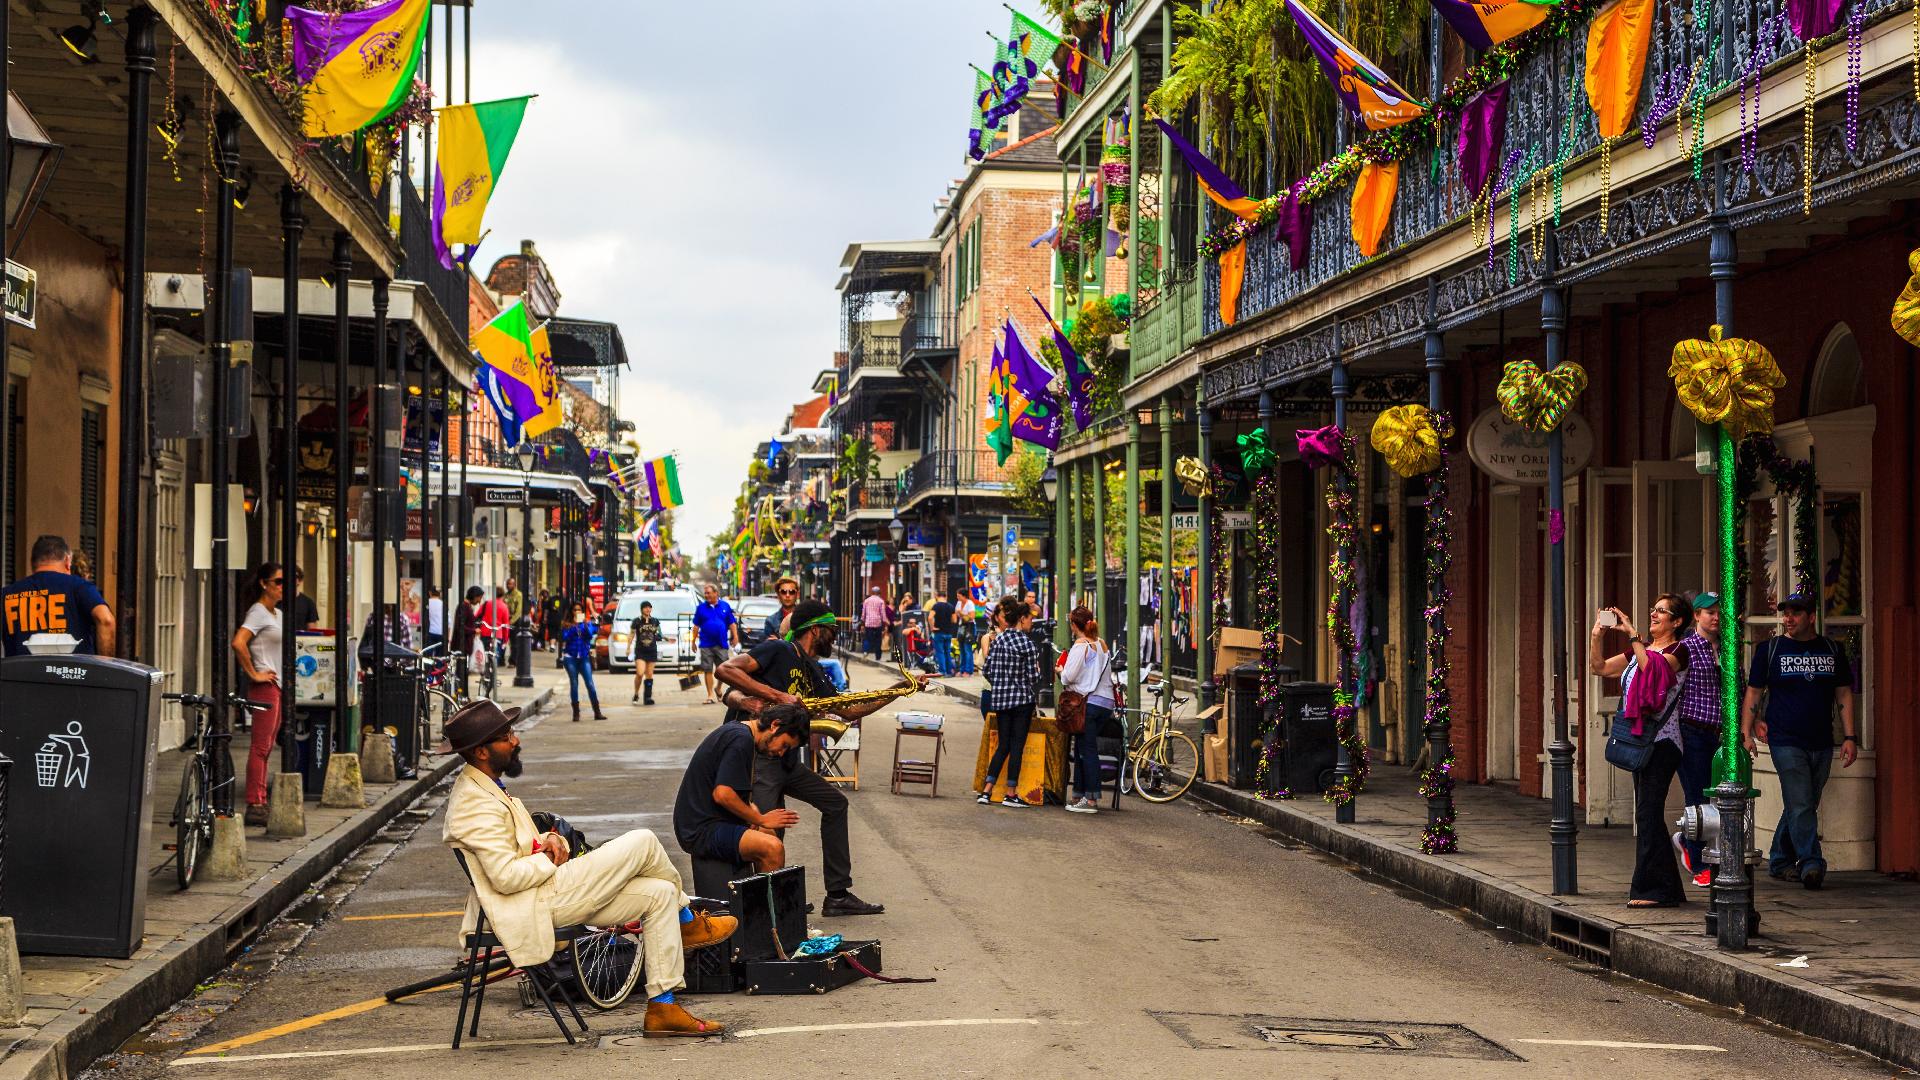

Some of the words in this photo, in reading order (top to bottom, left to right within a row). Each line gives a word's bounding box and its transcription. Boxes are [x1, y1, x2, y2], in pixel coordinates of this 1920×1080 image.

[5, 279, 28, 314] Royal
[1522, 454, 1576, 465] ORLNS
[489, 491, 520, 500] Orleans
[1232, 518, 1251, 527] Trade
[4, 593, 67, 635] FIRE
[1780, 656, 1835, 666] SPORTING
[45, 665, 88, 677] BigBelly
[1780, 665, 1816, 673] KANSAS
[1817, 665, 1835, 673] CITY
